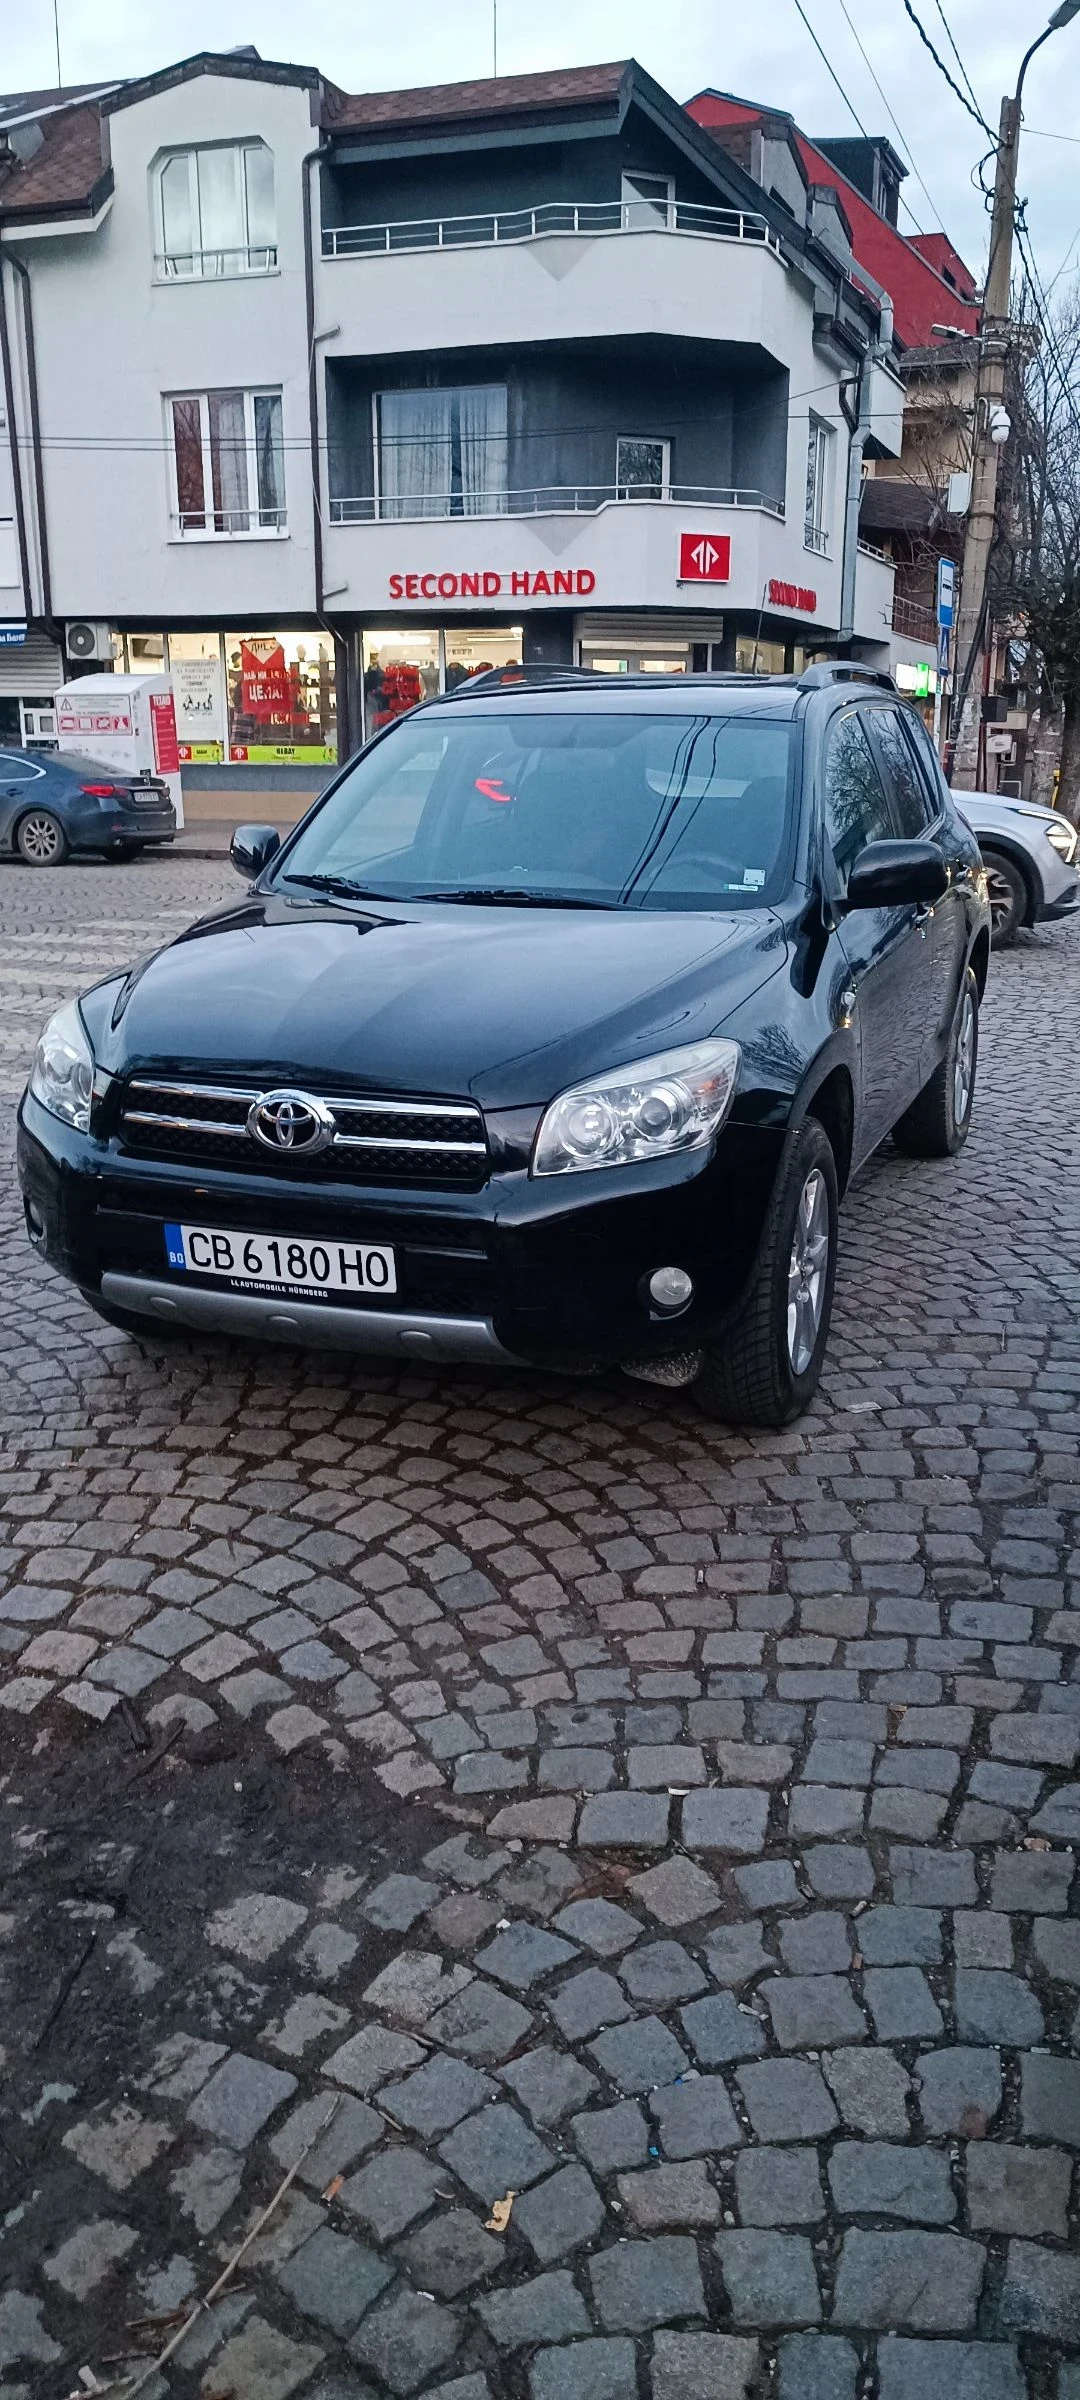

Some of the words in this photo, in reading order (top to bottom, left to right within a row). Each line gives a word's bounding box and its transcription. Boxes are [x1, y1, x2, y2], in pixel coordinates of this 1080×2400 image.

[389, 571, 501, 599] SECOND
[511, 569, 596, 595] HAND
[188, 1232, 235, 1270] CB
[243, 1238, 331, 1282] 6180
[338, 1247, 389, 1287] HO
[240, 1281, 287, 1293] AUTOMOBILE
[288, 1285, 329, 1298] NÜRNBERG
